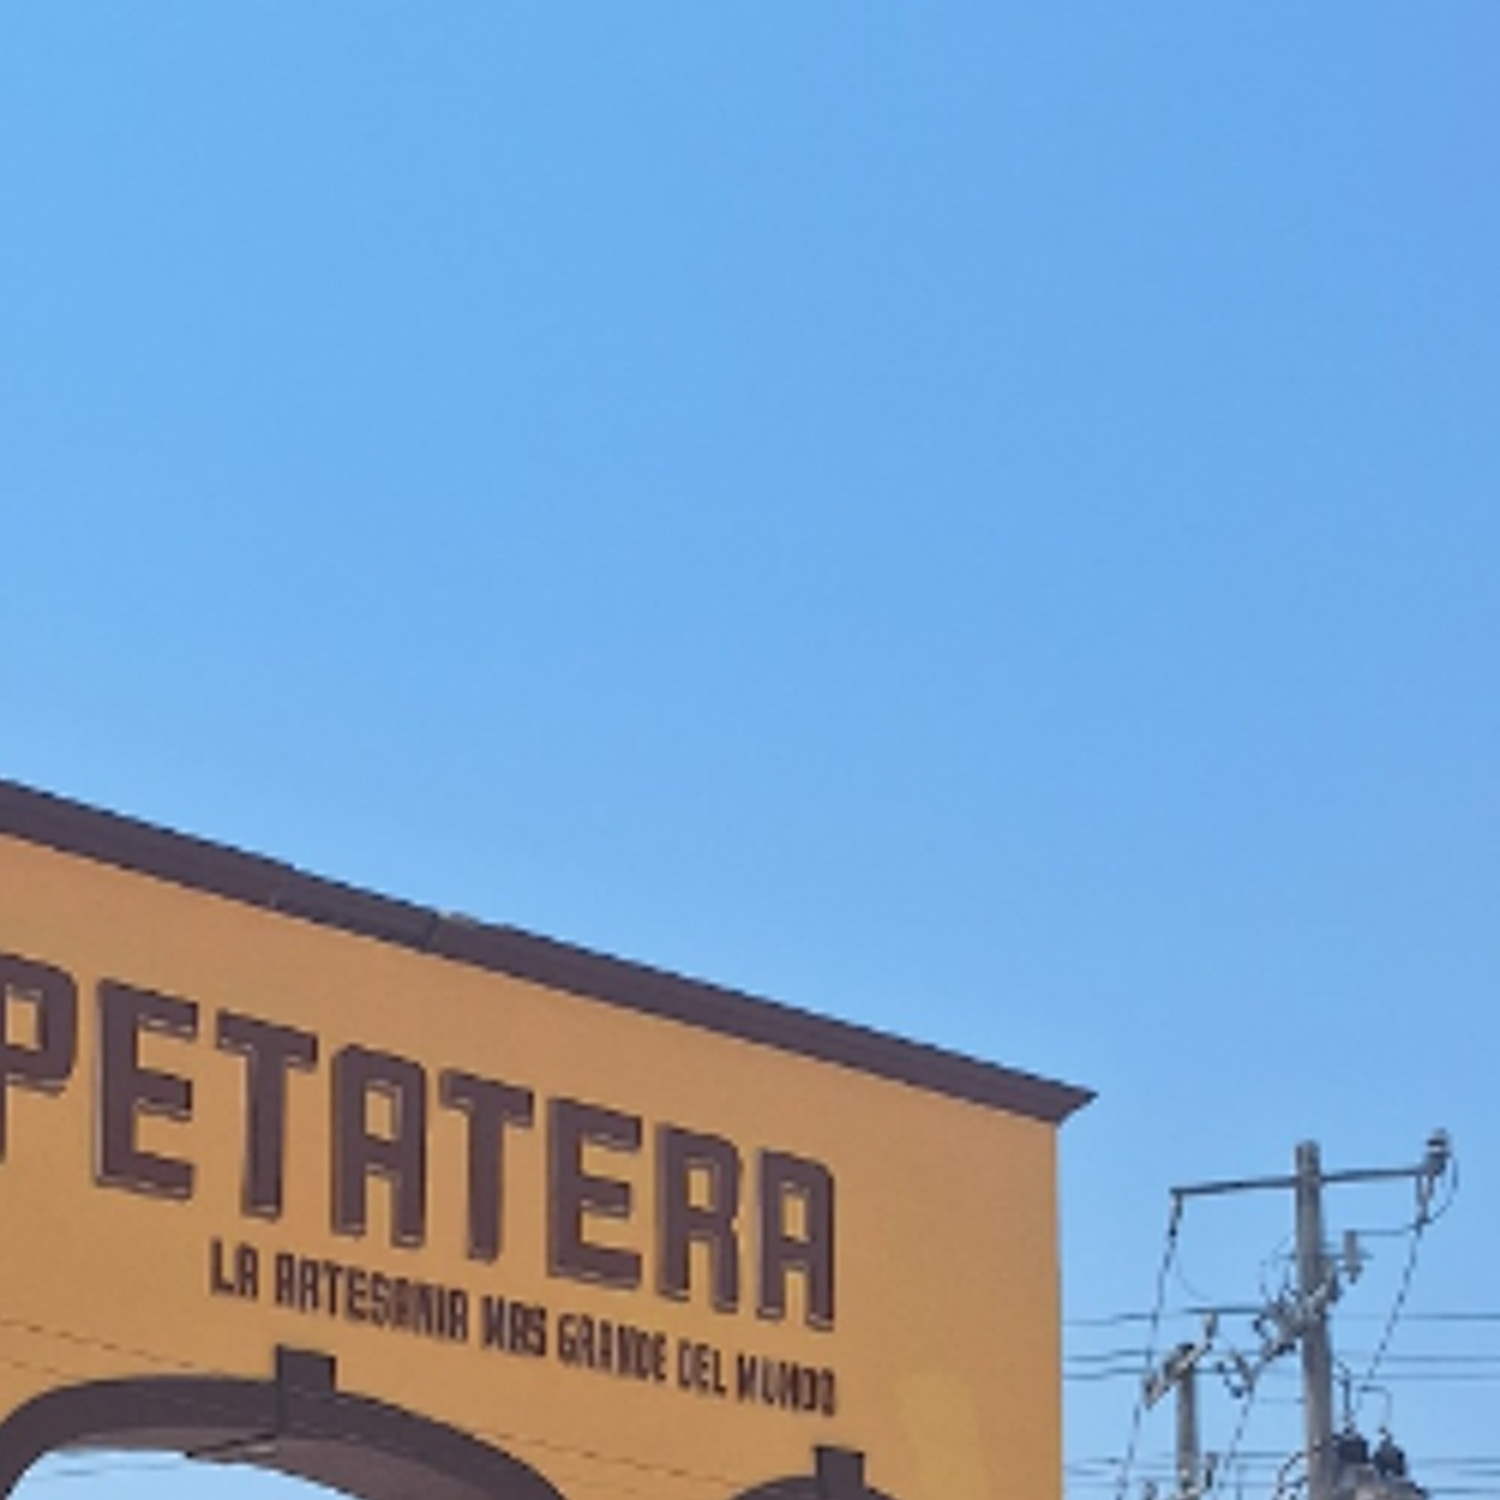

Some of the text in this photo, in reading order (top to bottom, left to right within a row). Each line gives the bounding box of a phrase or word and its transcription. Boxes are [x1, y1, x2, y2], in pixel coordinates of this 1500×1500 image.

[210, 1239, 837, 1417] LA ARTESANIA MAS GRANDE DEL MUNDO
